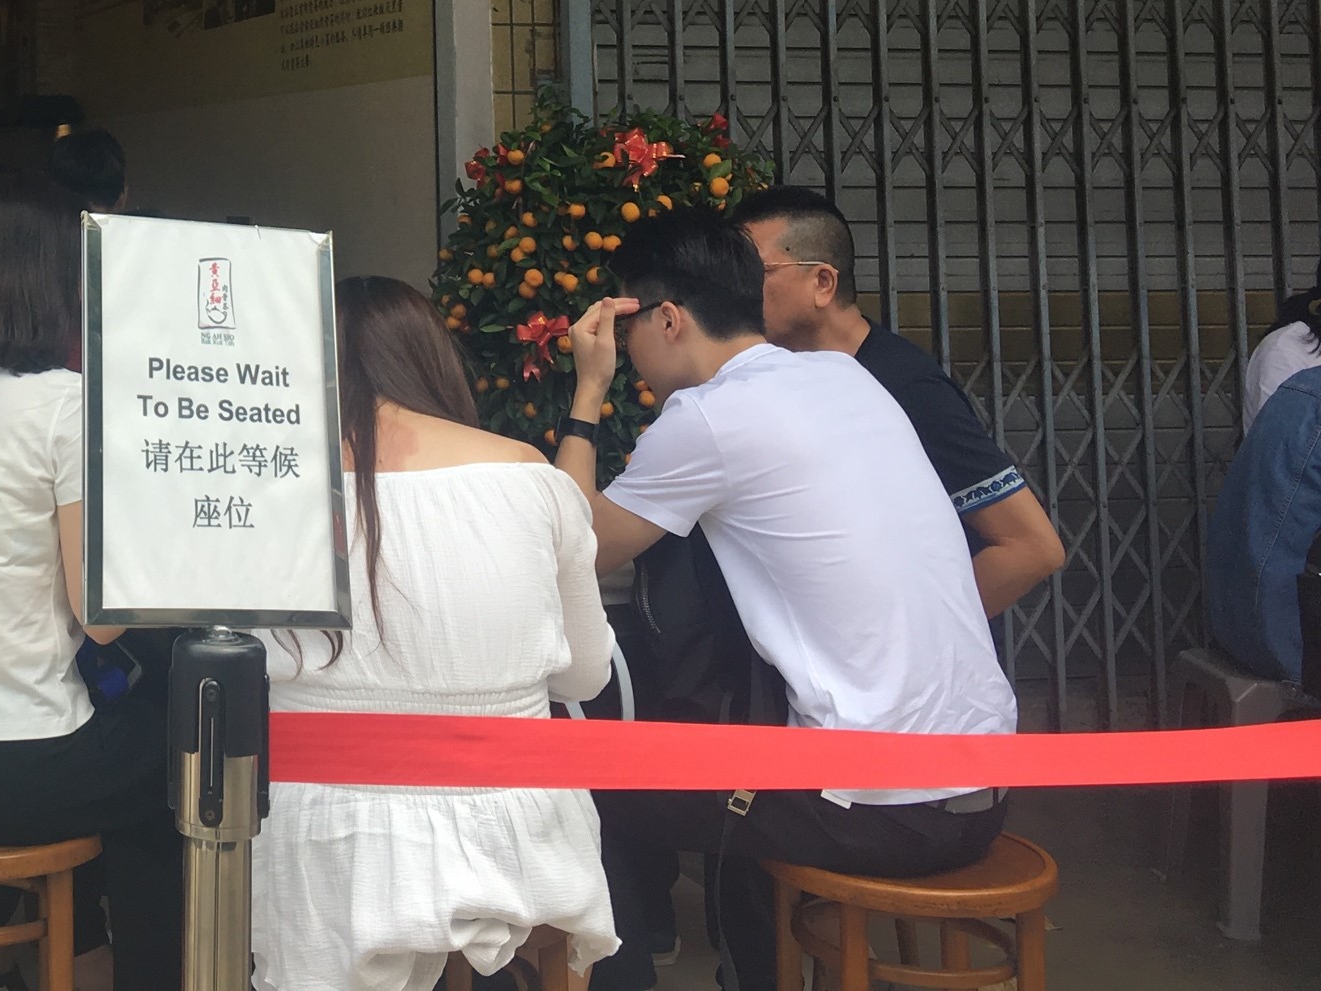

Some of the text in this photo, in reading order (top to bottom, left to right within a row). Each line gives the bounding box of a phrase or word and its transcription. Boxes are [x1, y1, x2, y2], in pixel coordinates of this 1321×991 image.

[148, 357, 290, 388] Please Wait
[137, 394, 301, 425] To Be Seated
[141, 439, 301, 478] 请在此等候
[192, 495, 255, 529] 座位
